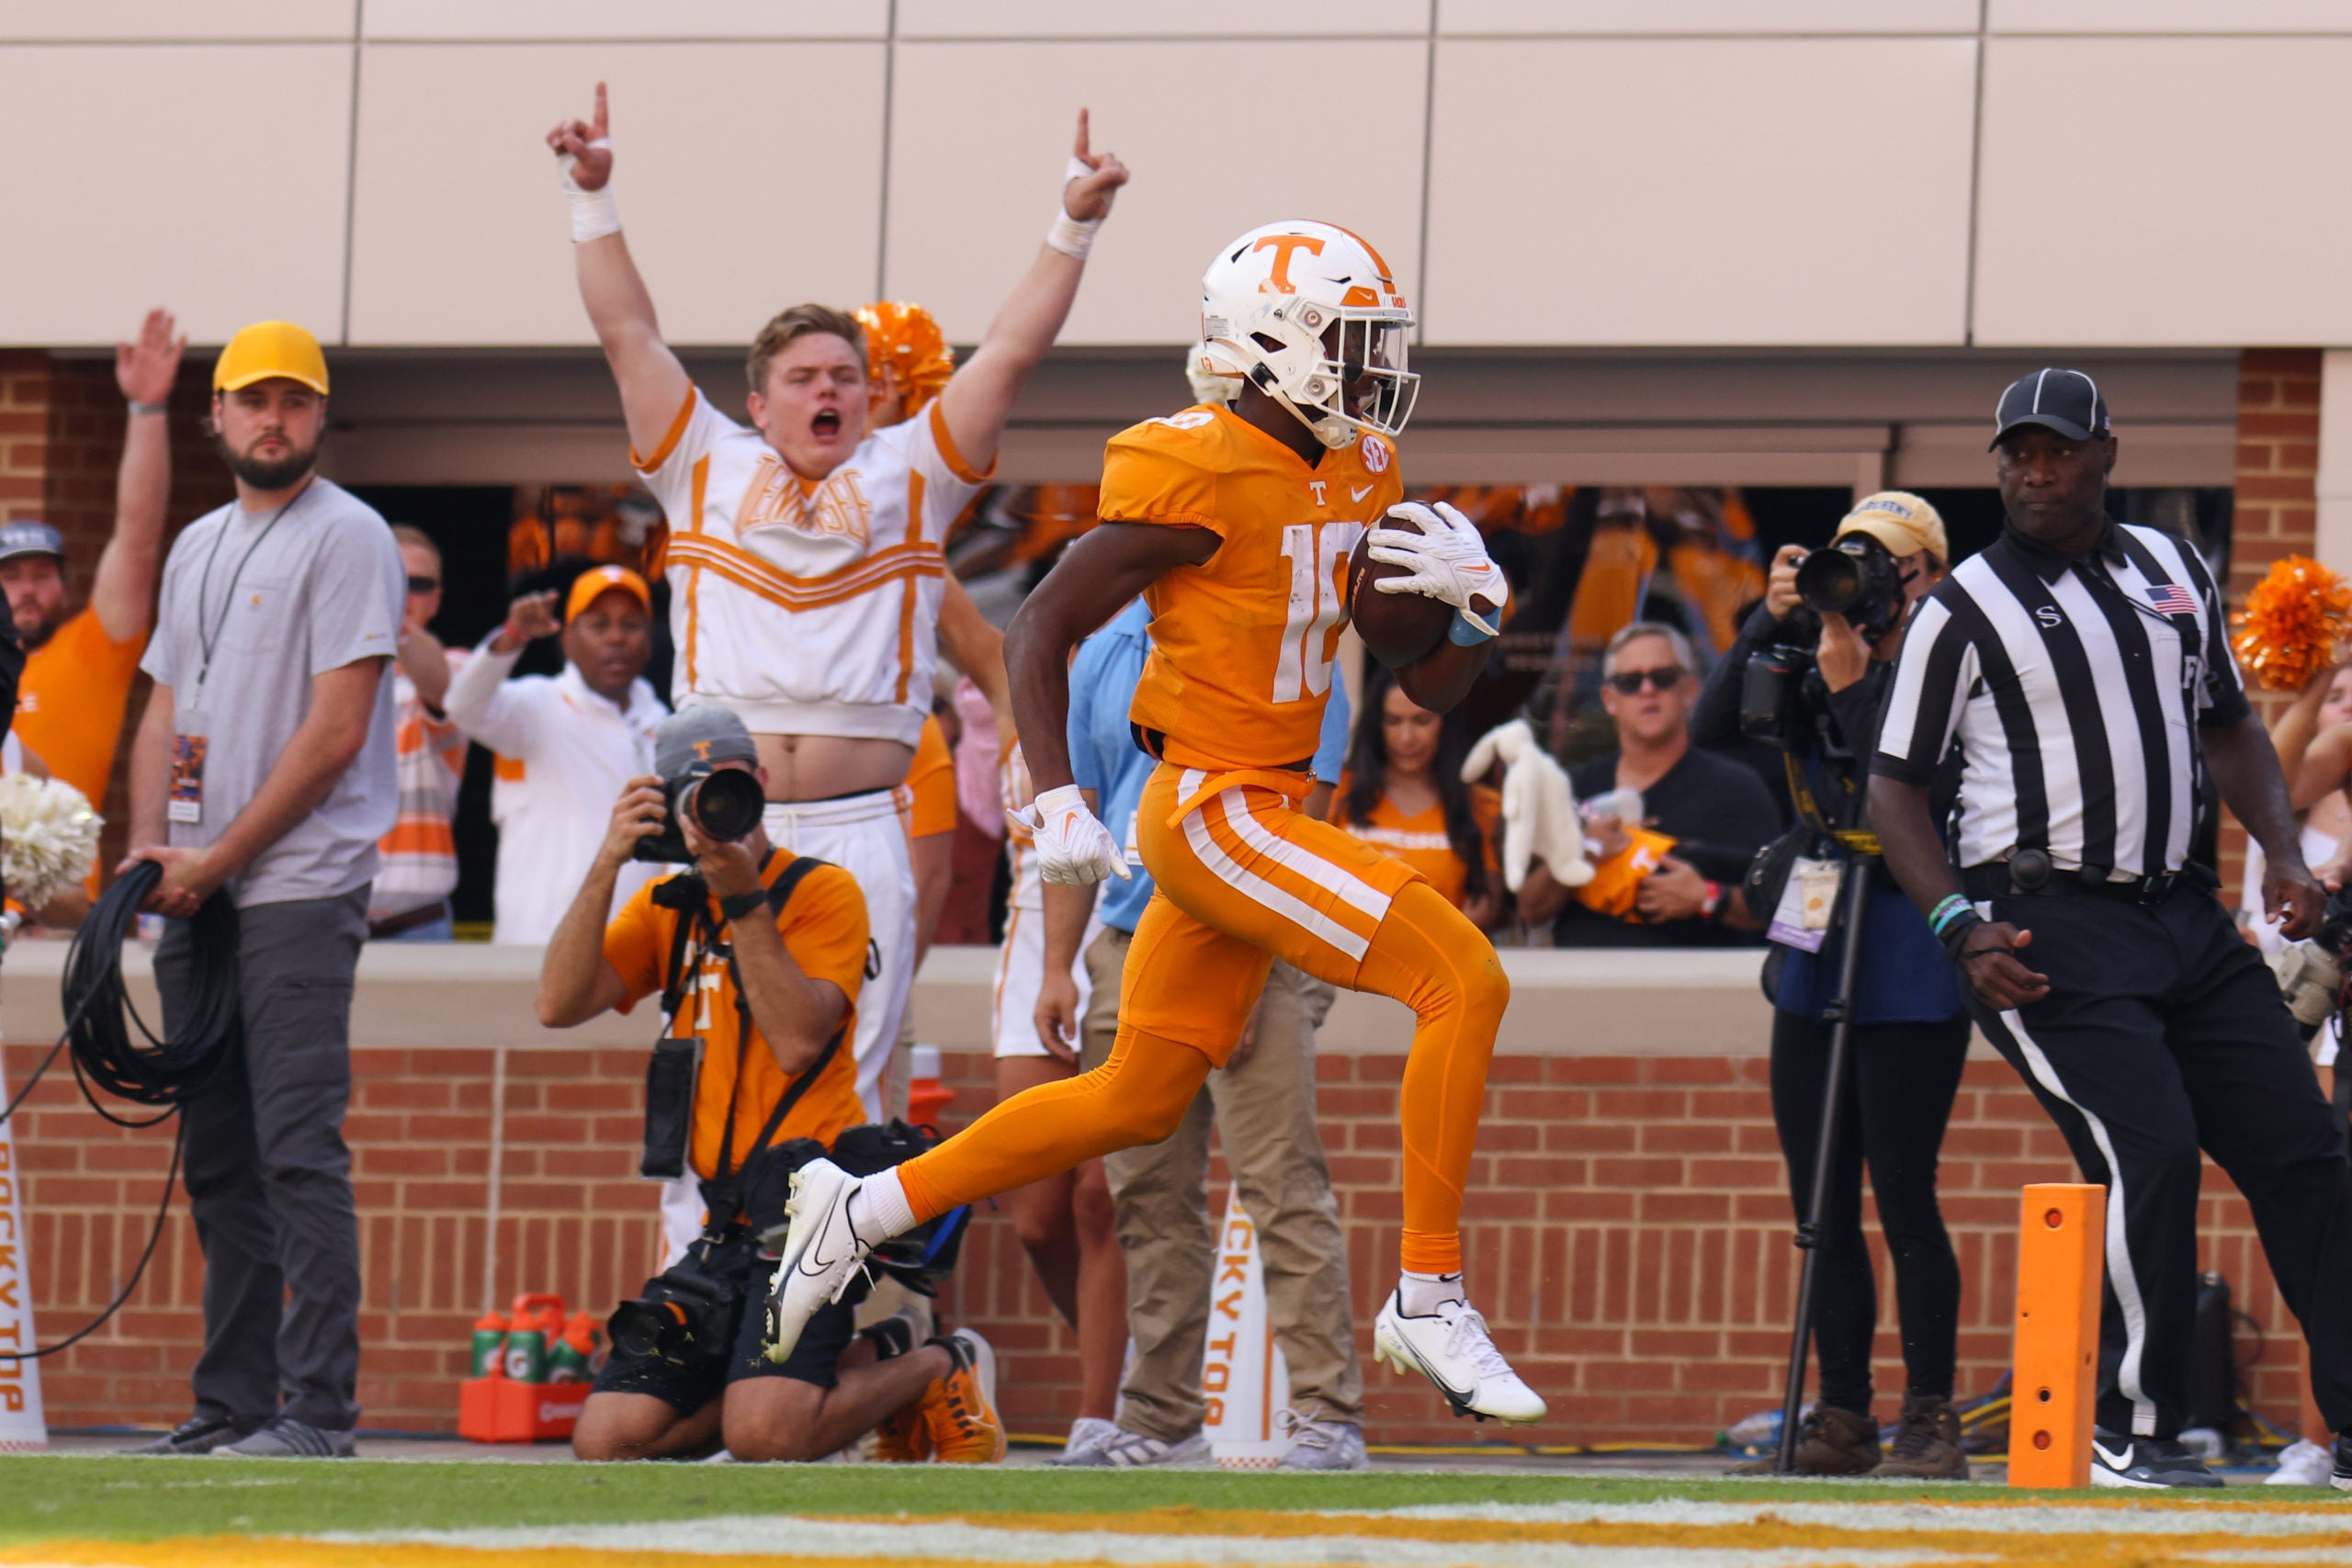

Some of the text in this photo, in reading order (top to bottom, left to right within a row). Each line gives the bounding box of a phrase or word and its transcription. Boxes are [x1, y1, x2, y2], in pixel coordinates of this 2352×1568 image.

[1252, 234, 1326, 295] T
[1362, 435, 1389, 473] SEC
[1309, 480, 1327, 505] T
[2035, 605, 2063, 629] S
[692, 739, 712, 761] T
[1203, 1191, 1255, 1427] CKY TOP
